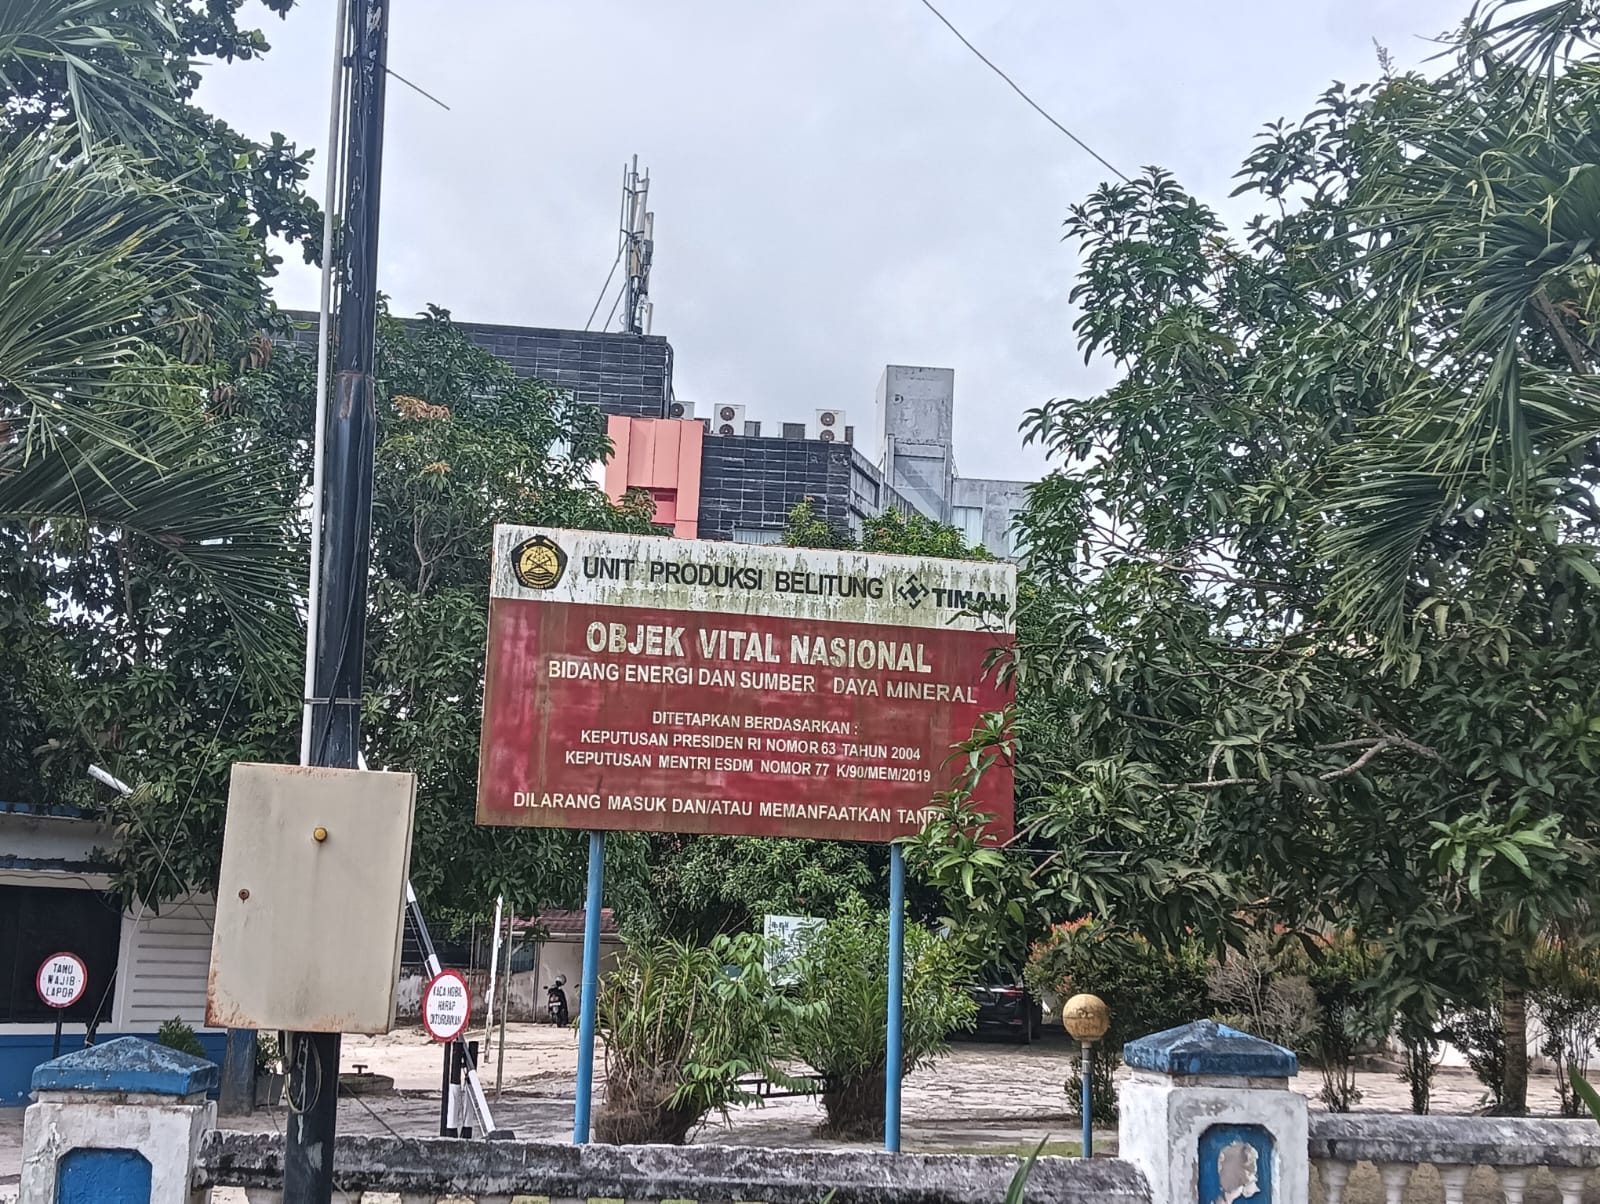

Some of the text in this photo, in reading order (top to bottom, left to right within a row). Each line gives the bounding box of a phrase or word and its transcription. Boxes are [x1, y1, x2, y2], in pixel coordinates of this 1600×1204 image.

[583, 556, 635, 580] UNIT
[650, 561, 762, 590] PRODUKSI
[775, 570, 883, 600] BELITUNG
[586, 621, 932, 673] OBJEK VITAL NASIONAL
[548, 660, 978, 705] BIDANG ENERGI DAN SUMBER DAYA MINERAL
[652, 711, 741, 729] DITETAPKAN
[744, 716, 850, 735] BERDASARKAN
[581, 729, 921, 761] KEPUTUSAN PRESIDEN RI NOMOR 63 TAHUN 2004
[565, 750, 931, 783] KEPUTUSAN MENTRI ESDM NOMOR 77 K/90/MEM/2019
[513, 792, 601, 810] DILARANG
[607, 795, 667, 812] MASUK
[671, 799, 753, 816] DAN/ATAU
[759, 802, 891, 824] MEMANFAATKAN
[48, 974, 75, 986] WAJIB
[53, 963, 73, 974] TAMU
[46, 987, 74, 997] LAPOR
